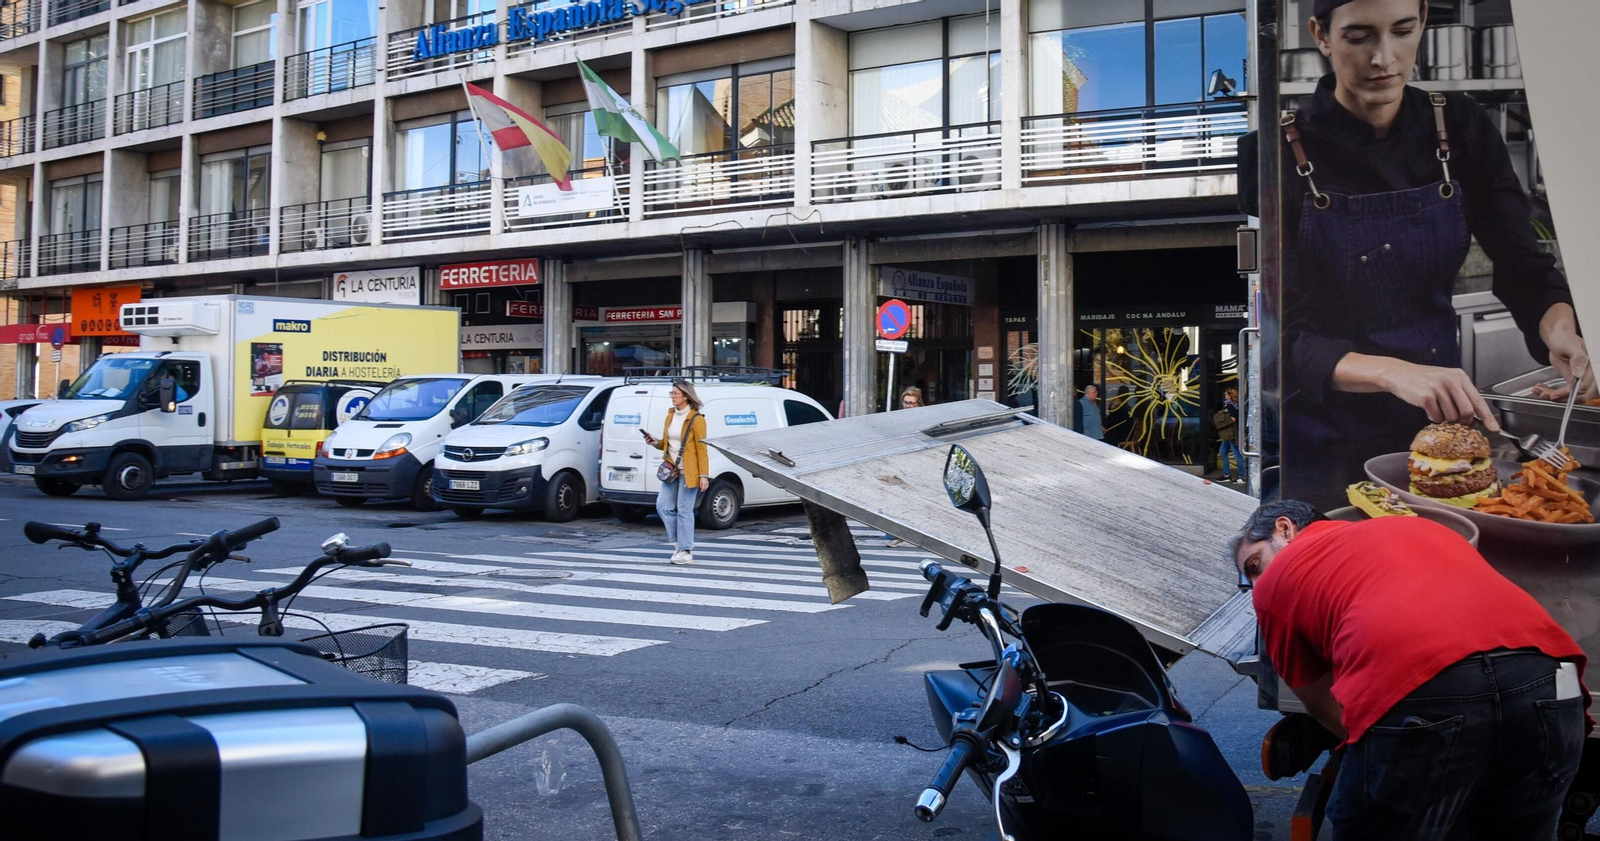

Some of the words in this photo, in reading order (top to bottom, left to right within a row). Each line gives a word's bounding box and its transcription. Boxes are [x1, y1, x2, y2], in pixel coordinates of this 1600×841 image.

[412, 24, 499, 62] Alianza
[508, 0, 624, 43] Española
[440, 263, 538, 286] FERRETERIA
[351, 280, 364, 293] LA
[369, 276, 416, 292] CENTURIA
[907, 273, 935, 289] Alianza
[936, 276, 967, 294] Española
[606, 311, 655, 320] FERRETERIA
[659, 310, 674, 318] SAN
[275, 321, 308, 331] makro
[19, 333, 35, 342] grupo
[461, 334, 472, 344] LA
[474, 333, 514, 344] CENTURIA
[322, 349, 387, 363] DISTRIBUCIÓN
[306, 366, 339, 377] DIARIA
[341, 367, 346, 377] A
[349, 365, 401, 378] HOSTELERÍA
